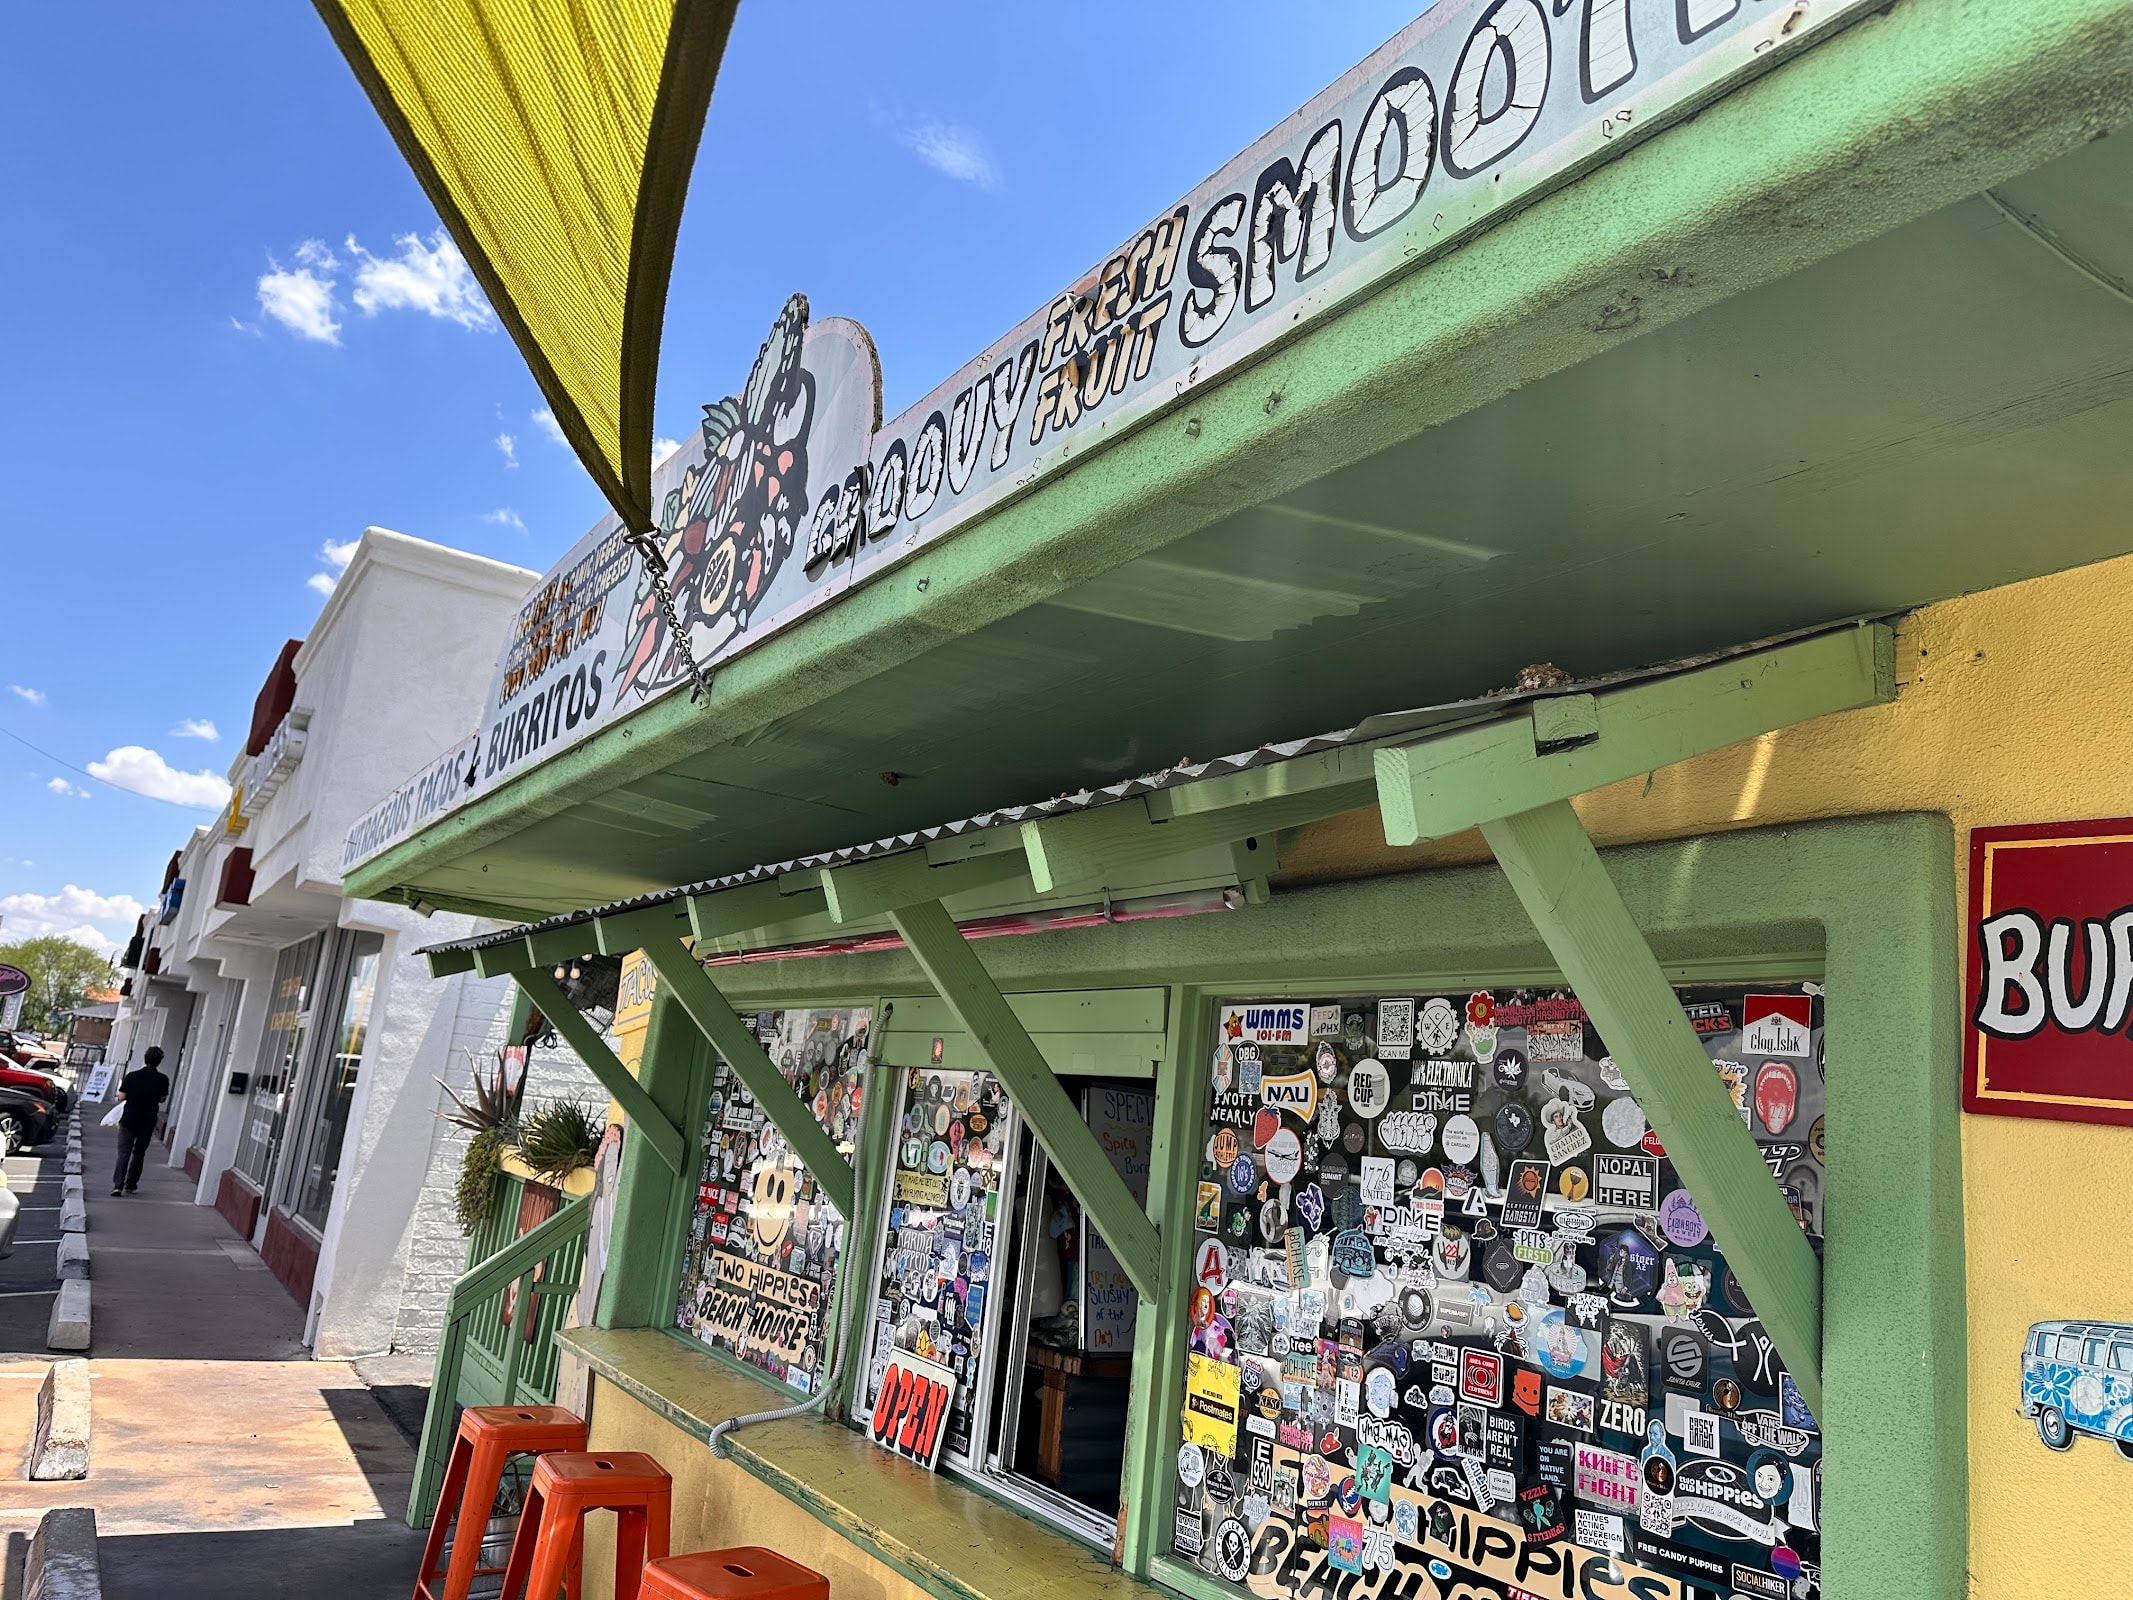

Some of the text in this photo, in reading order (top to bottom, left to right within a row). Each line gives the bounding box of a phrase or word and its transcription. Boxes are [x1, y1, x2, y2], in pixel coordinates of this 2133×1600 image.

[1179, 0, 1745, 349] SMOOT
[1039, 204, 1189, 372] FRESH
[1030, 291, 1172, 446] FRUIT
[804, 338, 1040, 572] GROOVY
[344, 785, 414, 866] OUTRAGEOUS
[414, 749, 466, 824] TACOS
[485, 649, 607, 780] BURRITOS
[1246, 1008, 1304, 1030] WMMS
[1238, 1046, 1256, 1061] DBG
[1380, 1049, 1409, 1058] SCAN ME
[1353, 1073, 1372, 1088] RED
[1426, 1060, 1476, 1088] ELECTRONICA
[1221, 1092, 1247, 1107] NOT
[1267, 1086, 1309, 1103] NAU
[1353, 1088, 1374, 1104] CUP
[1412, 1089, 1470, 1112] DIME
[1210, 1108, 1256, 1129] NEARLY
[1103, 1131, 1136, 1154] Spicy
[1215, 1135, 1238, 1149] JUMP
[1551, 1130, 1584, 1153] CHALINO
[1553, 1138, 1587, 1161] SANCHEZ
[1321, 1172, 1343, 1182] SUMMIT
[1599, 1158, 1652, 1177] NOPAL
[1363, 1163, 1393, 1193] 1776
[1362, 1188, 1392, 1201] UNITED
[1599, 1189, 1652, 1207] HERE
[1384, 1206, 1439, 1233] DIME
[1504, 1210, 1537, 1223] GANGSTA
[1667, 1217, 1701, 1234] CABIN BOYS
[898, 1229, 933, 1254] KARMA
[1521, 1231, 1546, 1249] PETS
[1517, 1250, 1550, 1262] FIRST!
[714, 1256, 745, 1283] TWO
[1089, 1286, 1131, 1306] SLUSHY
[699, 1291, 807, 1351] BEACH HOUSE
[810, 1312, 817, 1325] R
[1095, 1308, 1125, 1321] of the
[1690, 1311, 1714, 1343] Jesus
[1351, 1367, 1359, 1379] 12
[1666, 1376, 1702, 1389] SANTA CRUZ
[873, 1362, 948, 1464] OPEN
[1200, 1400, 1233, 1421] Postmates
[1600, 1399, 1646, 1437] ZERO
[1489, 1415, 1516, 1433] BIRDS
[1756, 1413, 1780, 1429] VANS
[1487, 1429, 1518, 1448] AREN'T
[1742, 1420, 1804, 1445] OFF THE WALL
[1257, 1441, 1271, 1463] E
[1490, 1445, 1514, 1460] REAL
[1539, 1446, 1568, 1456] YOU ARE
[1540, 1455, 1549, 1463] ON
[1254, 1462, 1272, 1490] 930
[1540, 1465, 1564, 1475] NATIVE
[1520, 1484, 1549, 1502] PIZZA
[1307, 1499, 1328, 1507] SUNSET
[1577, 1511, 1609, 1525] NATIVES
[1577, 1520, 1605, 1531] ACTING
[1577, 1527, 1623, 1543] SOVEREIGN
[1362, 1528, 1395, 1571] 75
[1637, 1541, 1723, 1574] FREE CANDY PUPPIES
[1216, 1550, 1249, 1580] COLLECTIVE
